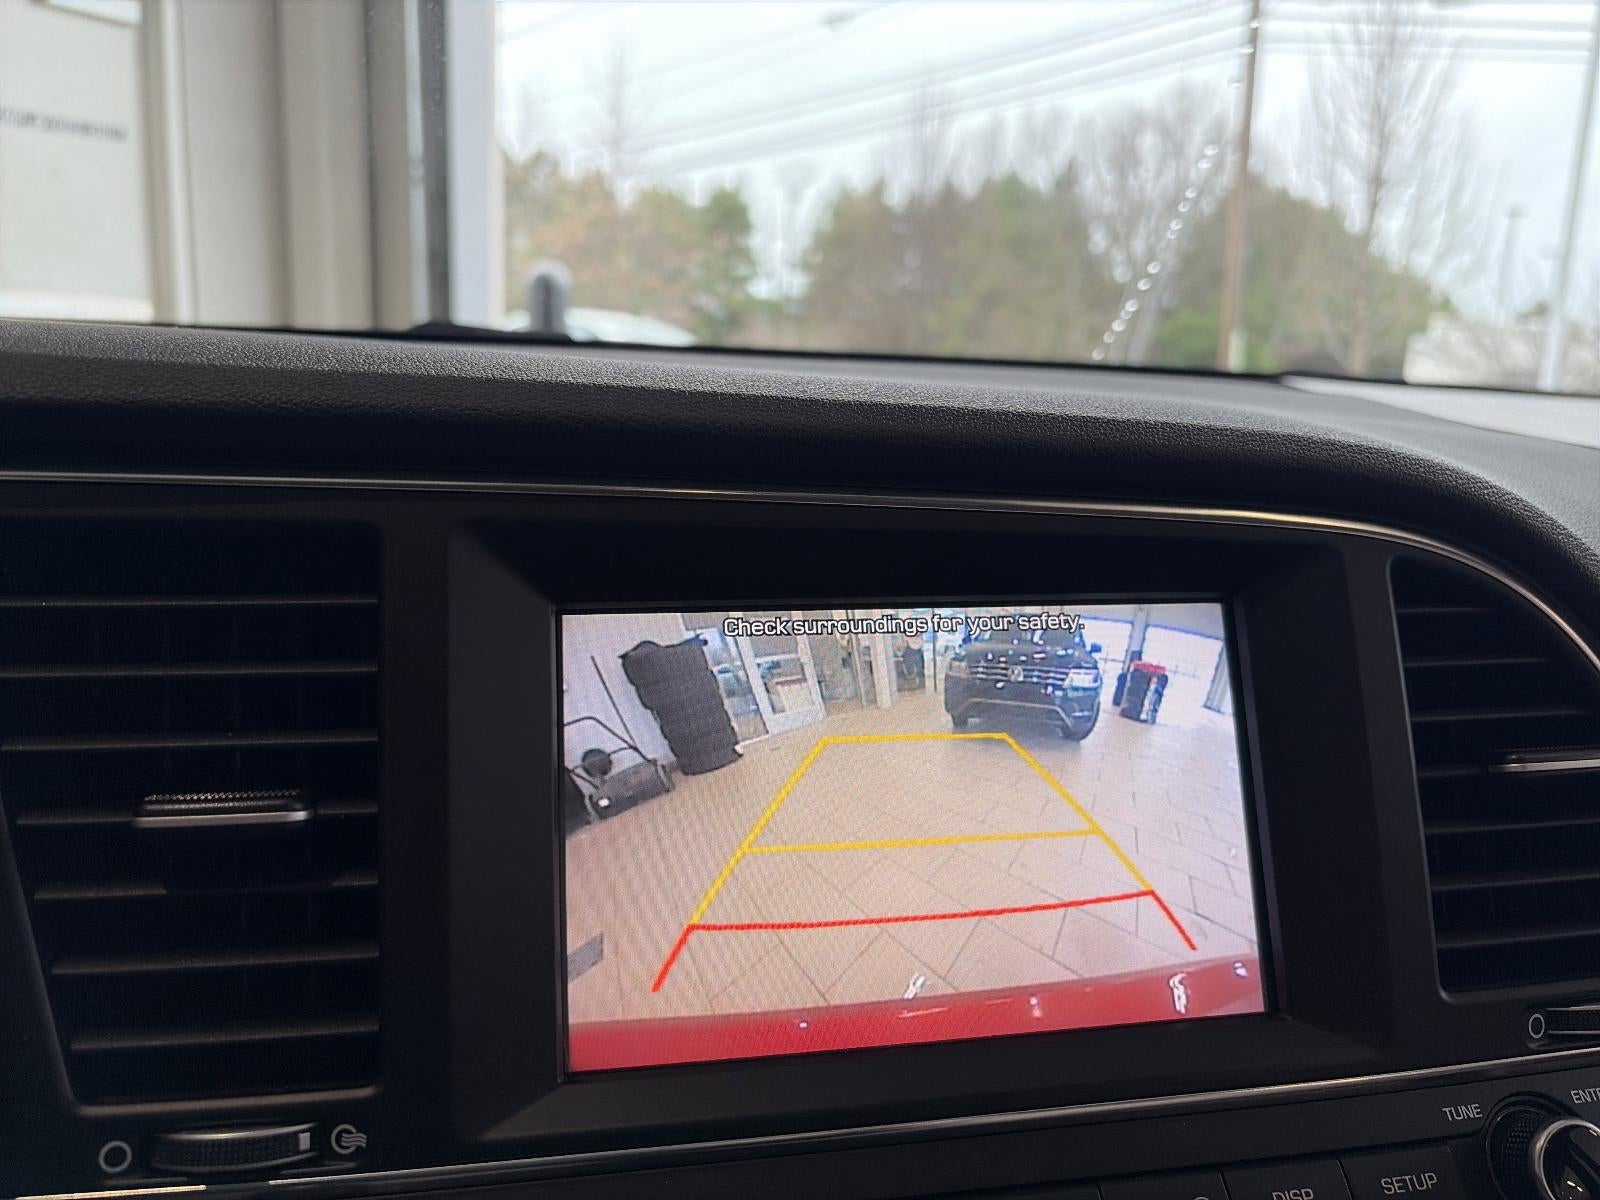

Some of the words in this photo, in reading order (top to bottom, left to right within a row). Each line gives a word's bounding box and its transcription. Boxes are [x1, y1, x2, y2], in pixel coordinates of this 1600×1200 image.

[723, 617, 789, 636] Check
[793, 614, 928, 637] surroundings
[932, 614, 963, 632] for
[967, 613, 1014, 634] your
[1018, 612, 1085, 630] safety.
[1442, 1104, 1483, 1121] TUNE
[1381, 1172, 1438, 1195] SETUP
